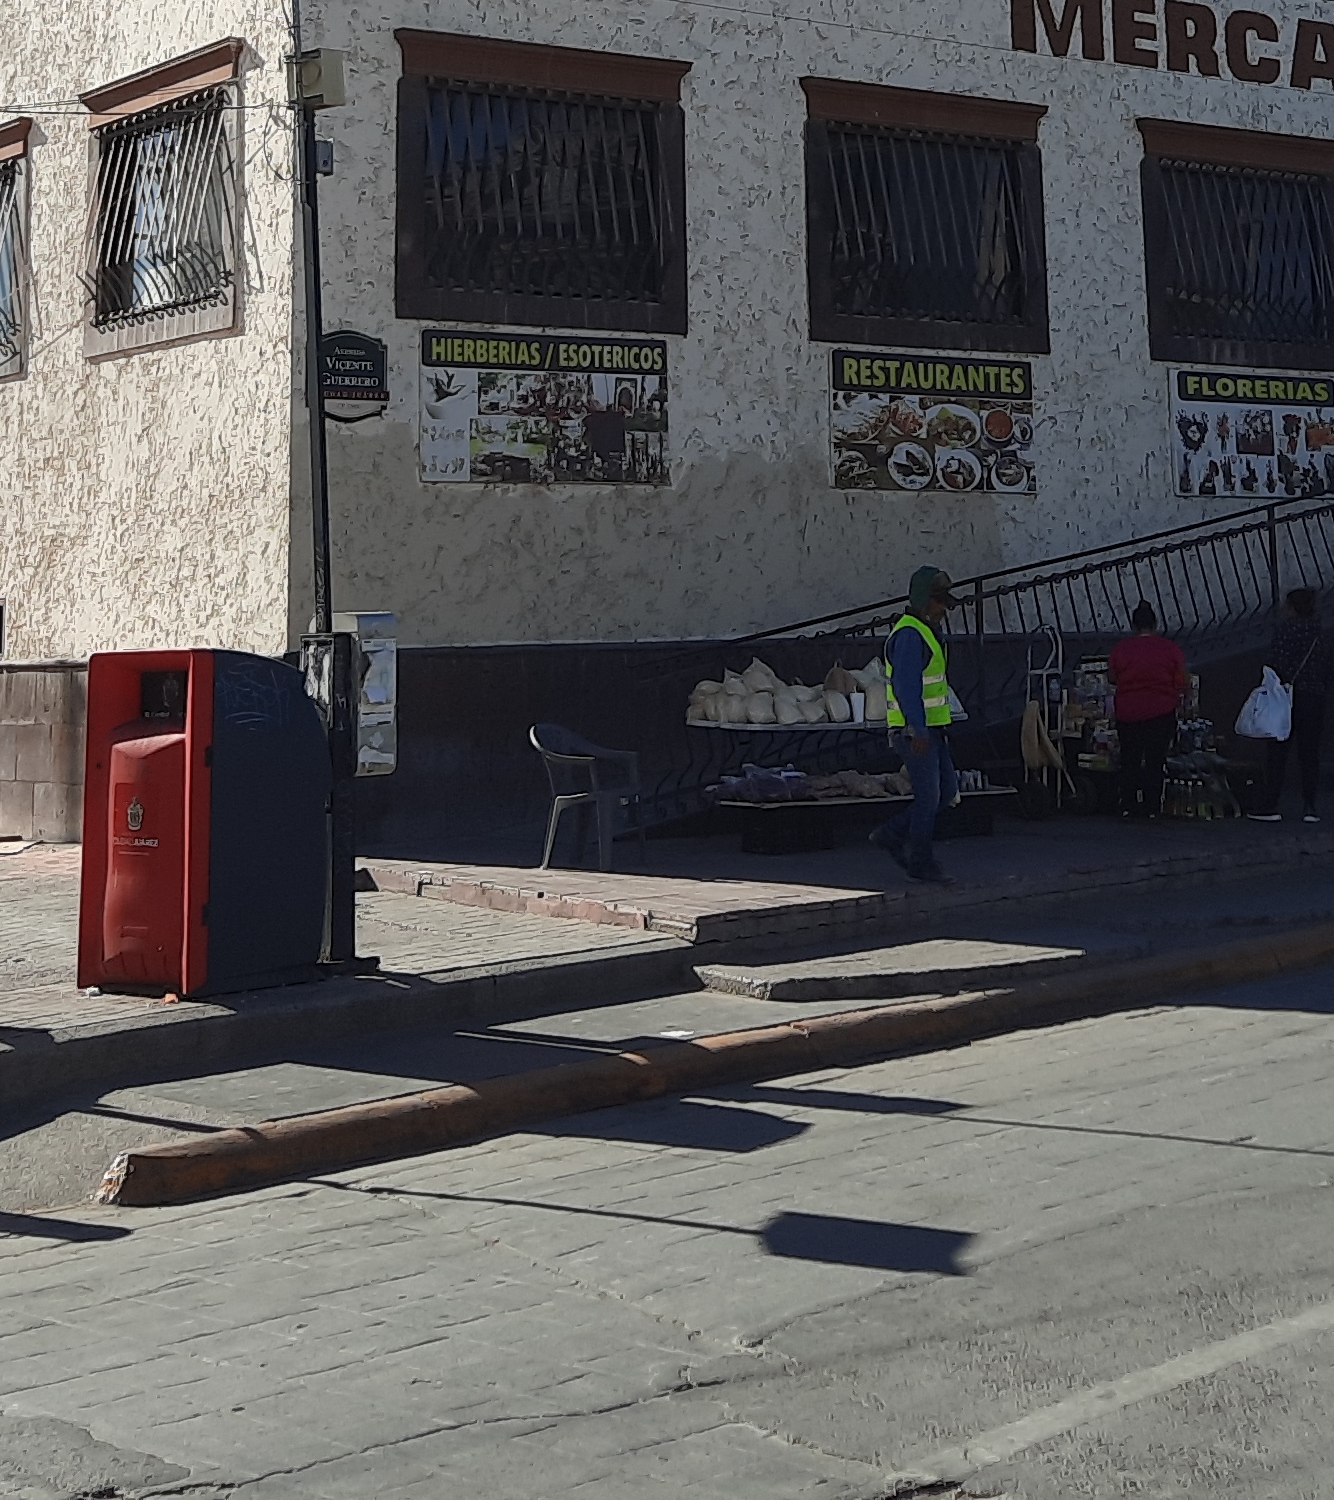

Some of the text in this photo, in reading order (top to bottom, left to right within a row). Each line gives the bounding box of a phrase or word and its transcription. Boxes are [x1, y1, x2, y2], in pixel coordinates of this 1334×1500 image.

[326, 357, 374, 371] VICENTE
[431, 337, 664, 371] HIERBERIAS / ESOTERICOS
[322, 372, 379, 387] GUERRERO
[843, 357, 1025, 394] RESTAURANTES
[1186, 375, 1329, 402] FLORERIAS
